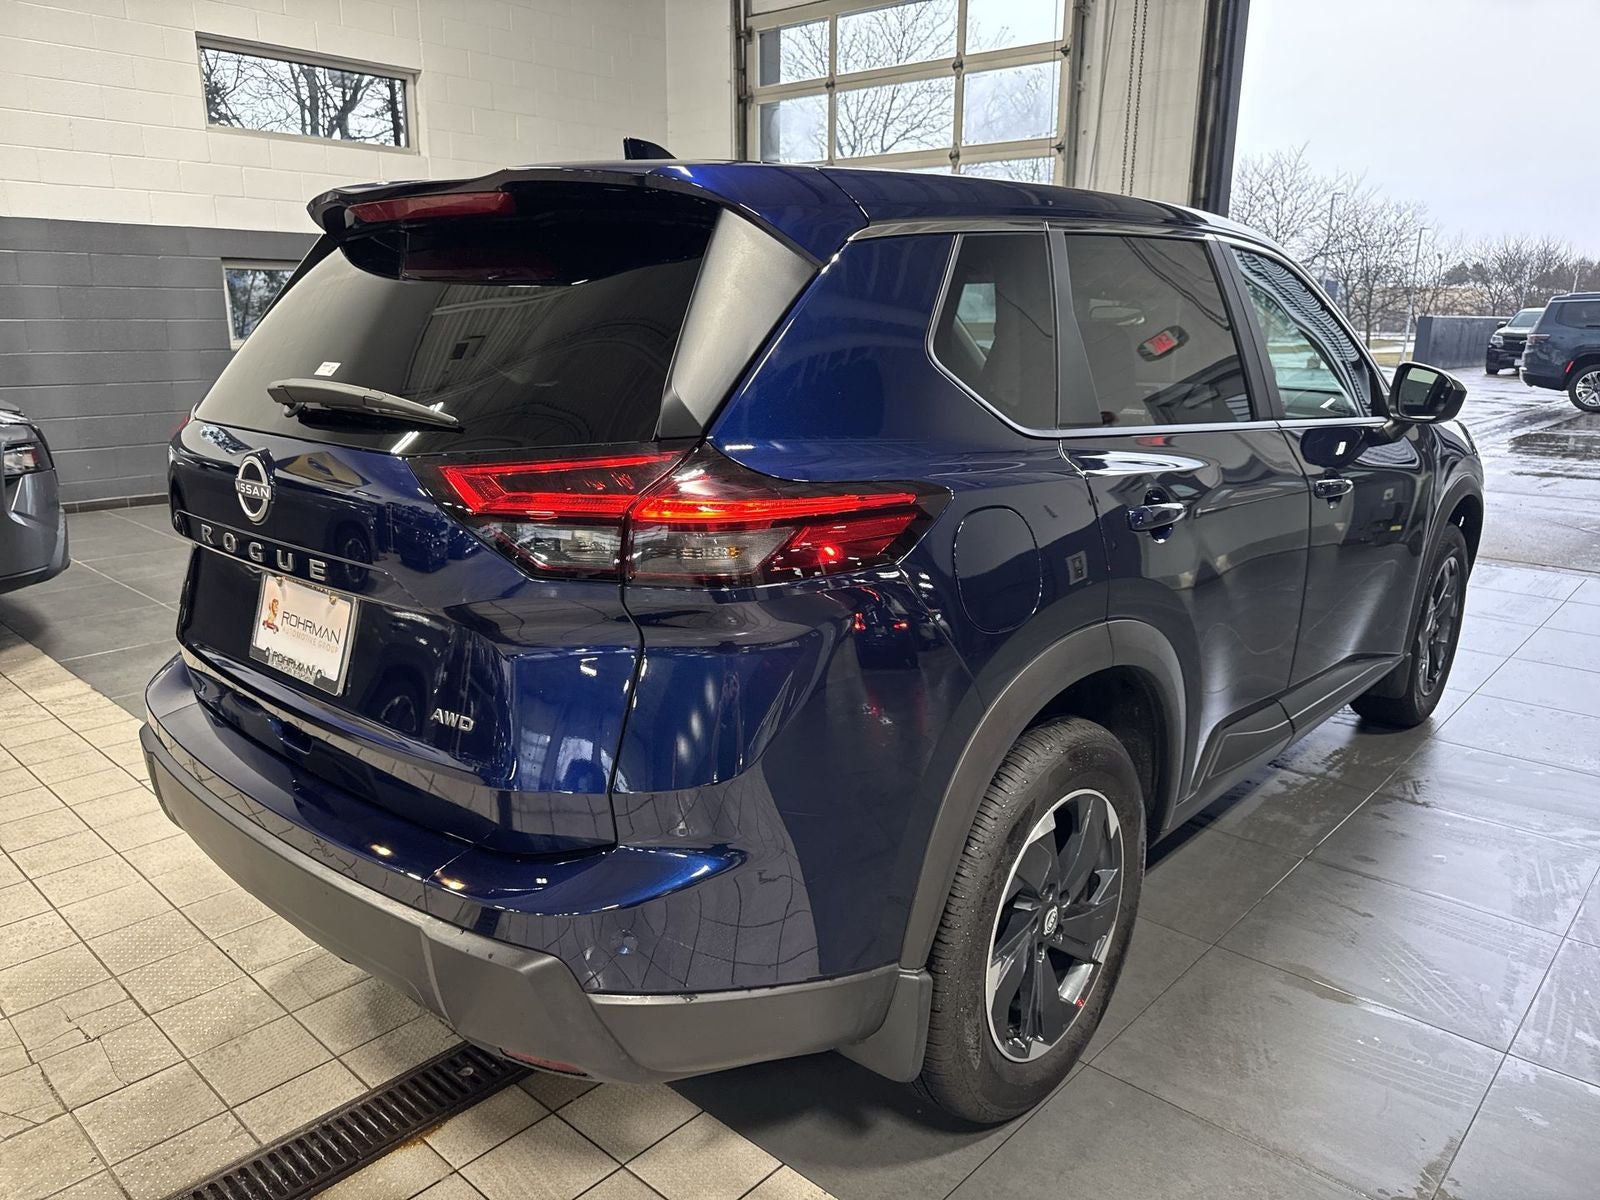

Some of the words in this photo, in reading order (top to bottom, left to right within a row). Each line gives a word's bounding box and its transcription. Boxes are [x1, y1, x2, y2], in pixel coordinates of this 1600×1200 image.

[201, 524, 327, 581] ROGUE
[281, 611, 341, 645] ROHRMAN
[430, 708, 474, 731] AWD
